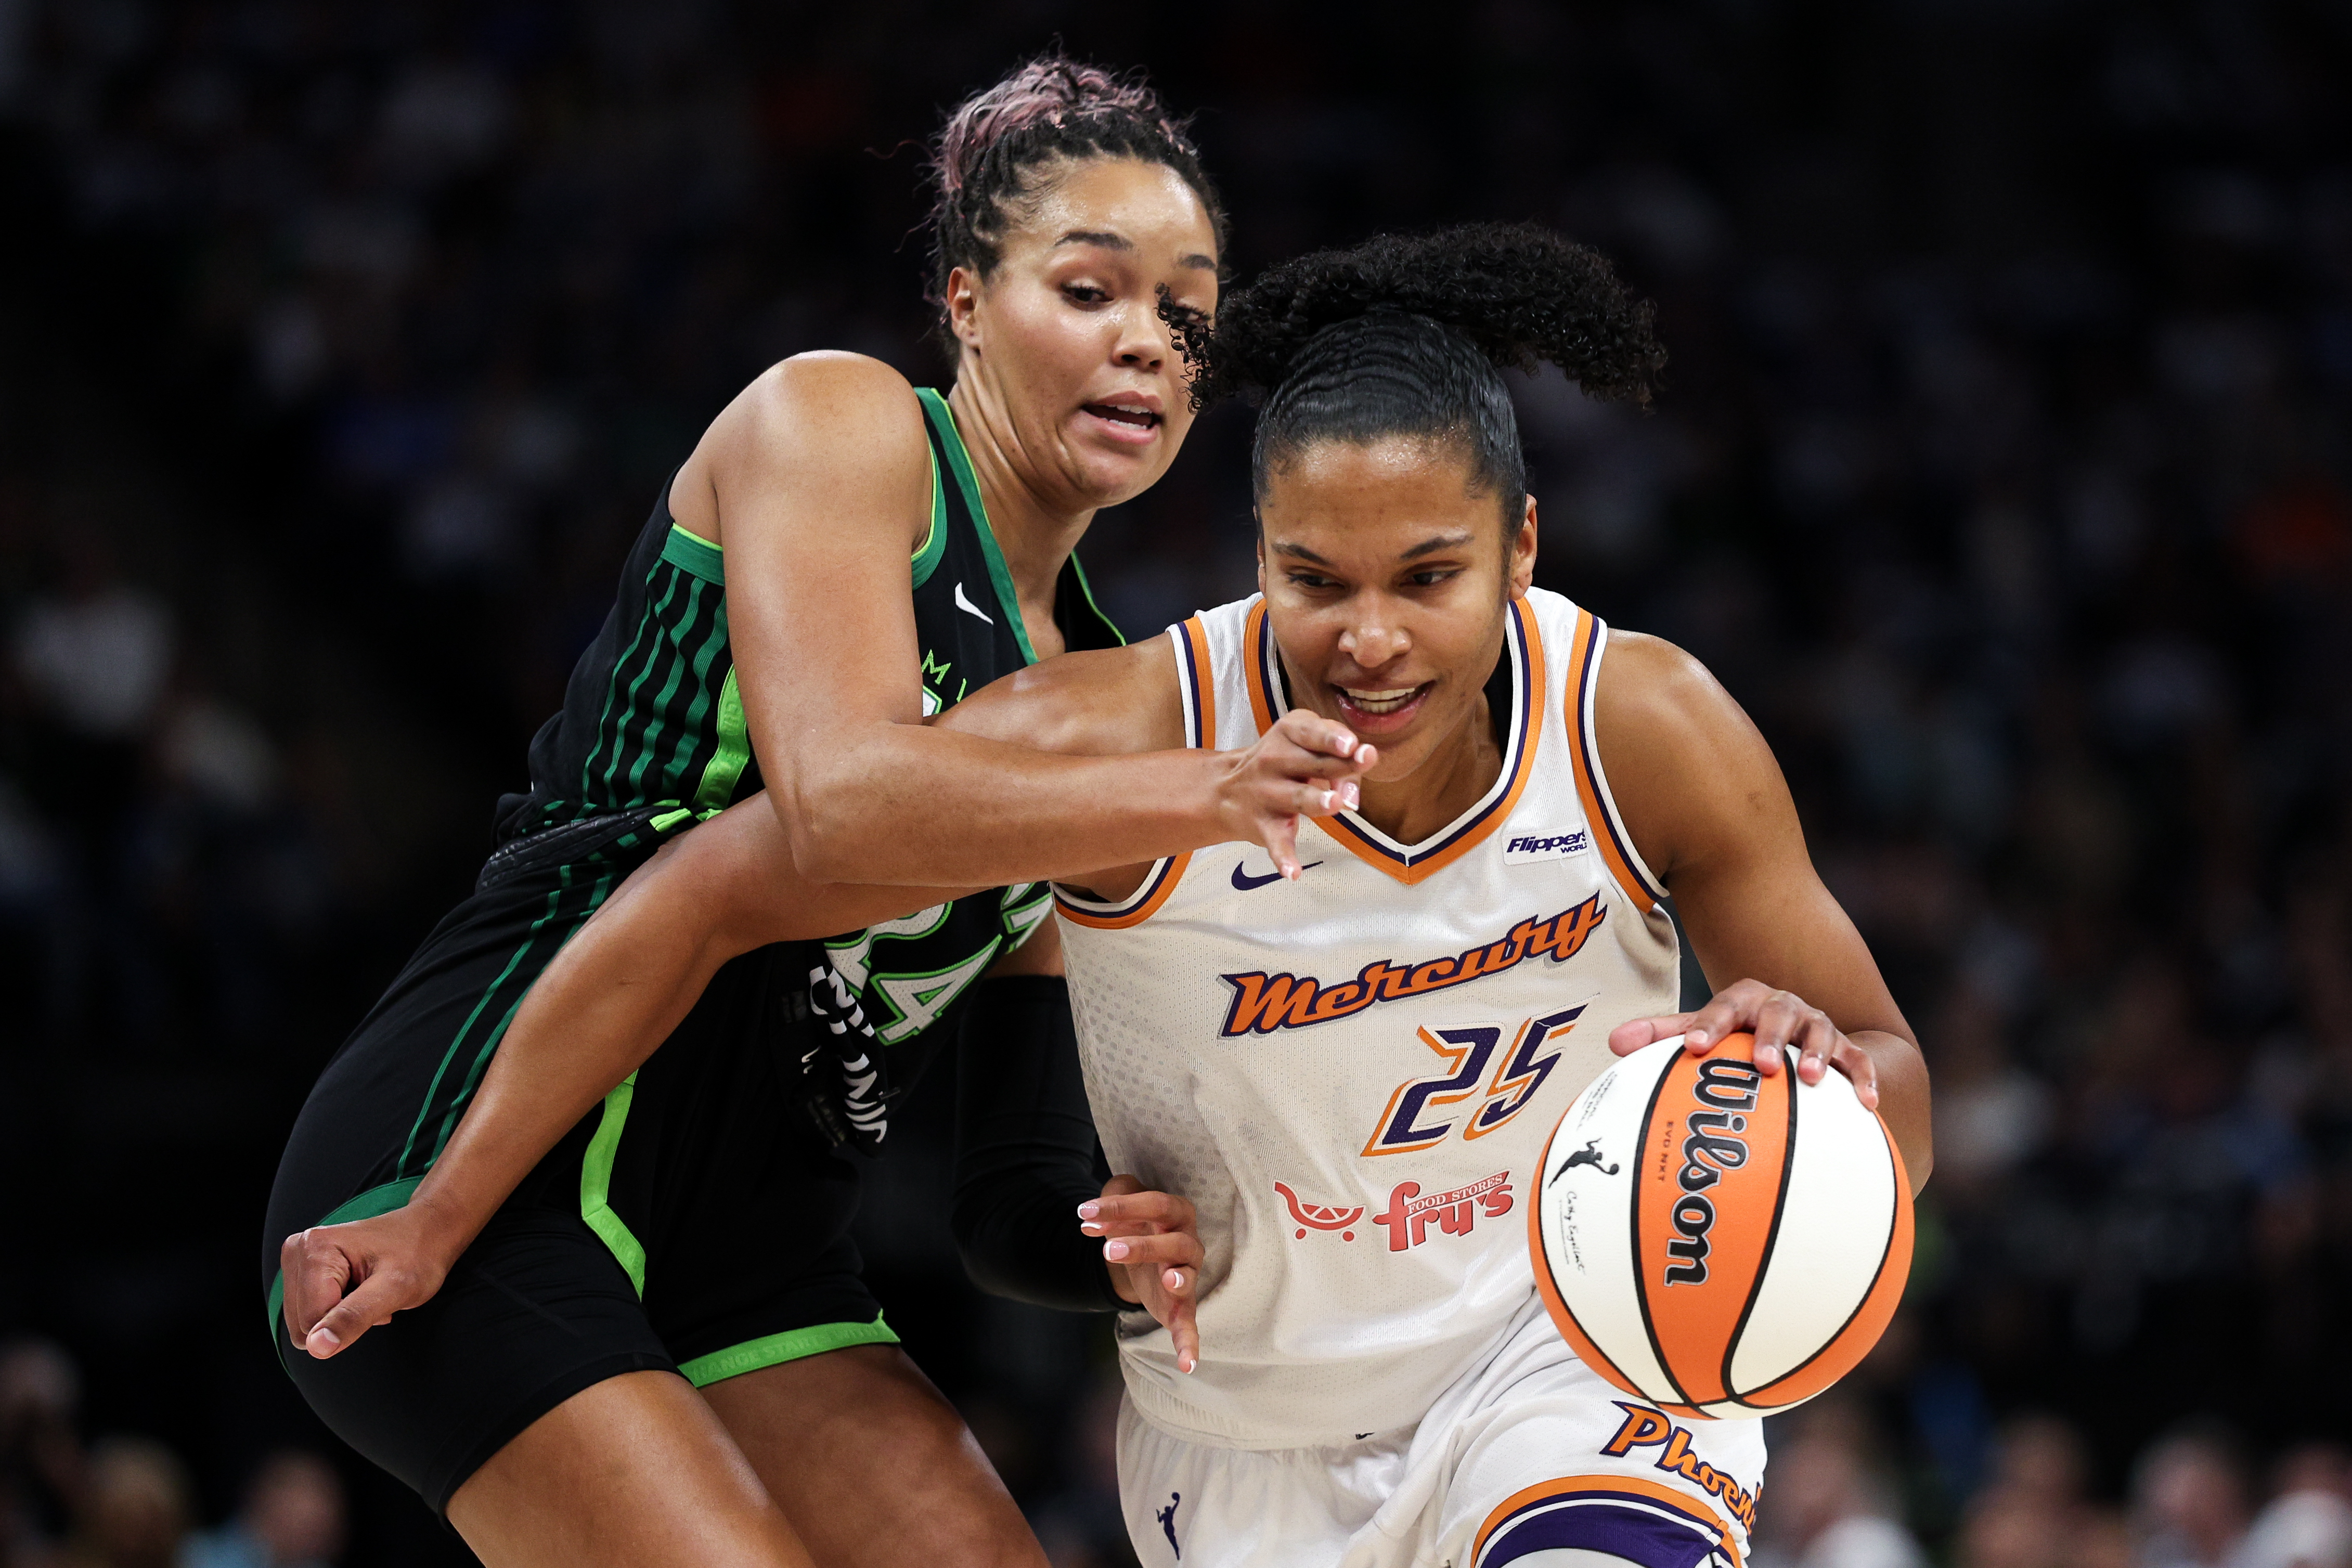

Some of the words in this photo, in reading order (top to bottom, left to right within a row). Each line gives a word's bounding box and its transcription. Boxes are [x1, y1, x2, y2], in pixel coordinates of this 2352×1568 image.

[1220, 890, 1608, 1039] Mercury
[1360, 1001, 1590, 1158] 25
[1407, 1194, 1446, 1215] FOOD
[1451, 1174, 1503, 1202] STORES
[1663, 1056, 1763, 1288] Wilson
[692, 1349, 760, 1381] HANGE
[1599, 1400, 1762, 1541] Phoen
